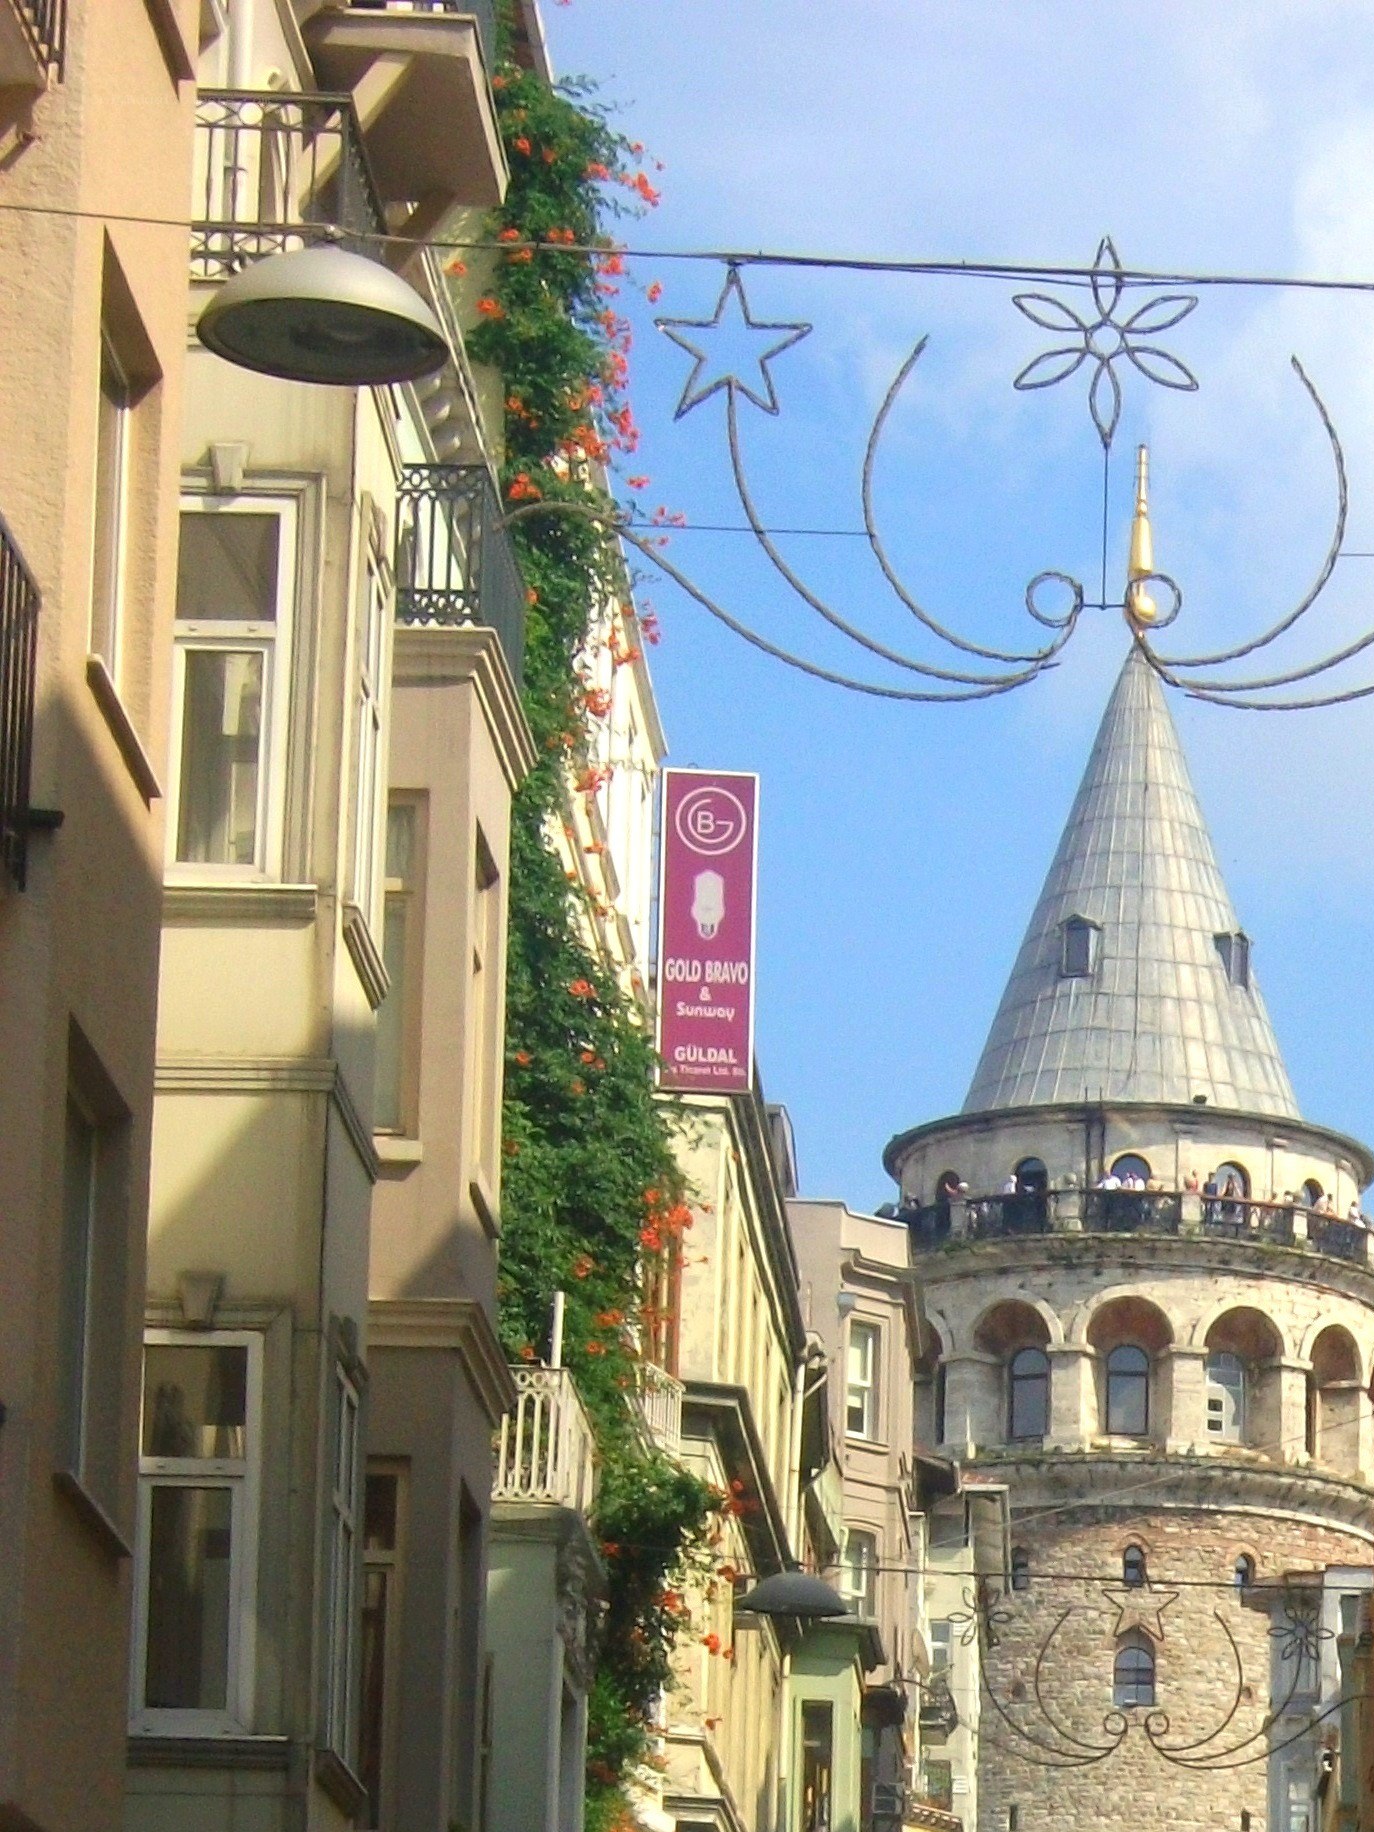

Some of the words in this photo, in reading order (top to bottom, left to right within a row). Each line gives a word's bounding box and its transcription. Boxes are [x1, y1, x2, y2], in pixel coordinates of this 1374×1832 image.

[665, 958, 701, 982] GOLD
[705, 960, 748, 985] BRAVO
[699, 986, 712, 1001] &
[676, 1001, 736, 1022] Sunway
[674, 1043, 737, 1063] GÜLDAL
